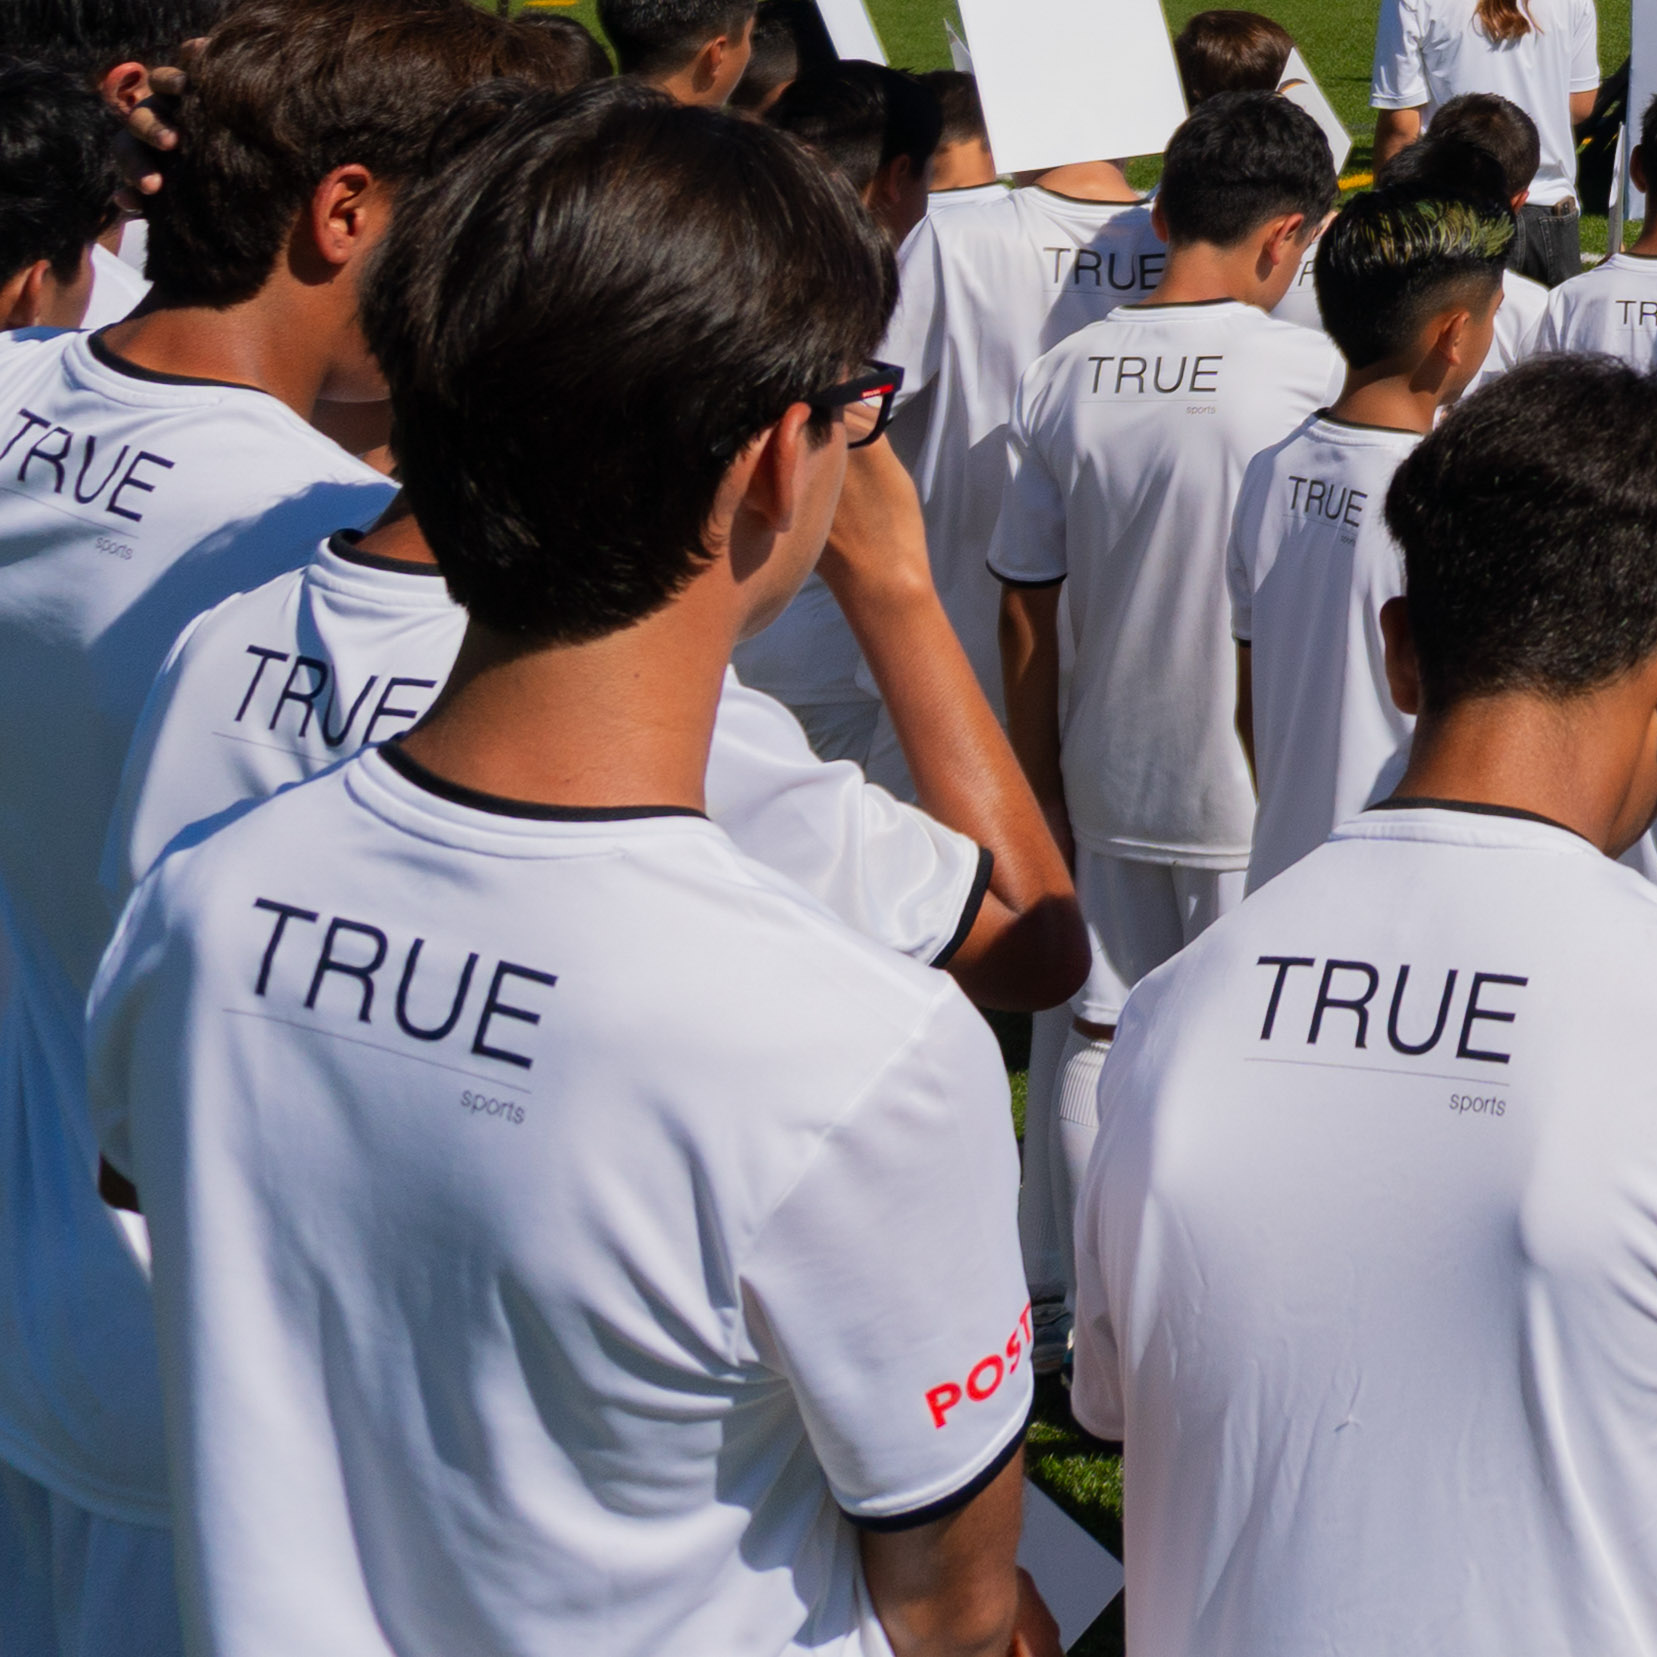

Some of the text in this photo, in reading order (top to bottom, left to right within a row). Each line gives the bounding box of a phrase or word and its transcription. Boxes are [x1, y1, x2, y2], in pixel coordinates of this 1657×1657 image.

[1043, 247, 1164, 291] TRUE
[1088, 355, 1223, 394] TRUE
[1186, 404, 1216, 415] sports
[0, 408, 175, 522] TRUE
[1289, 476, 1367, 527] TRUE
[95, 536, 134, 560] sports
[235, 645, 437, 747] TRUE
[252, 898, 558, 1071] TRUE
[1256, 955, 1529, 1064] TRUE
[460, 1087, 526, 1125] sports
[1449, 1090, 1506, 1117] sports
